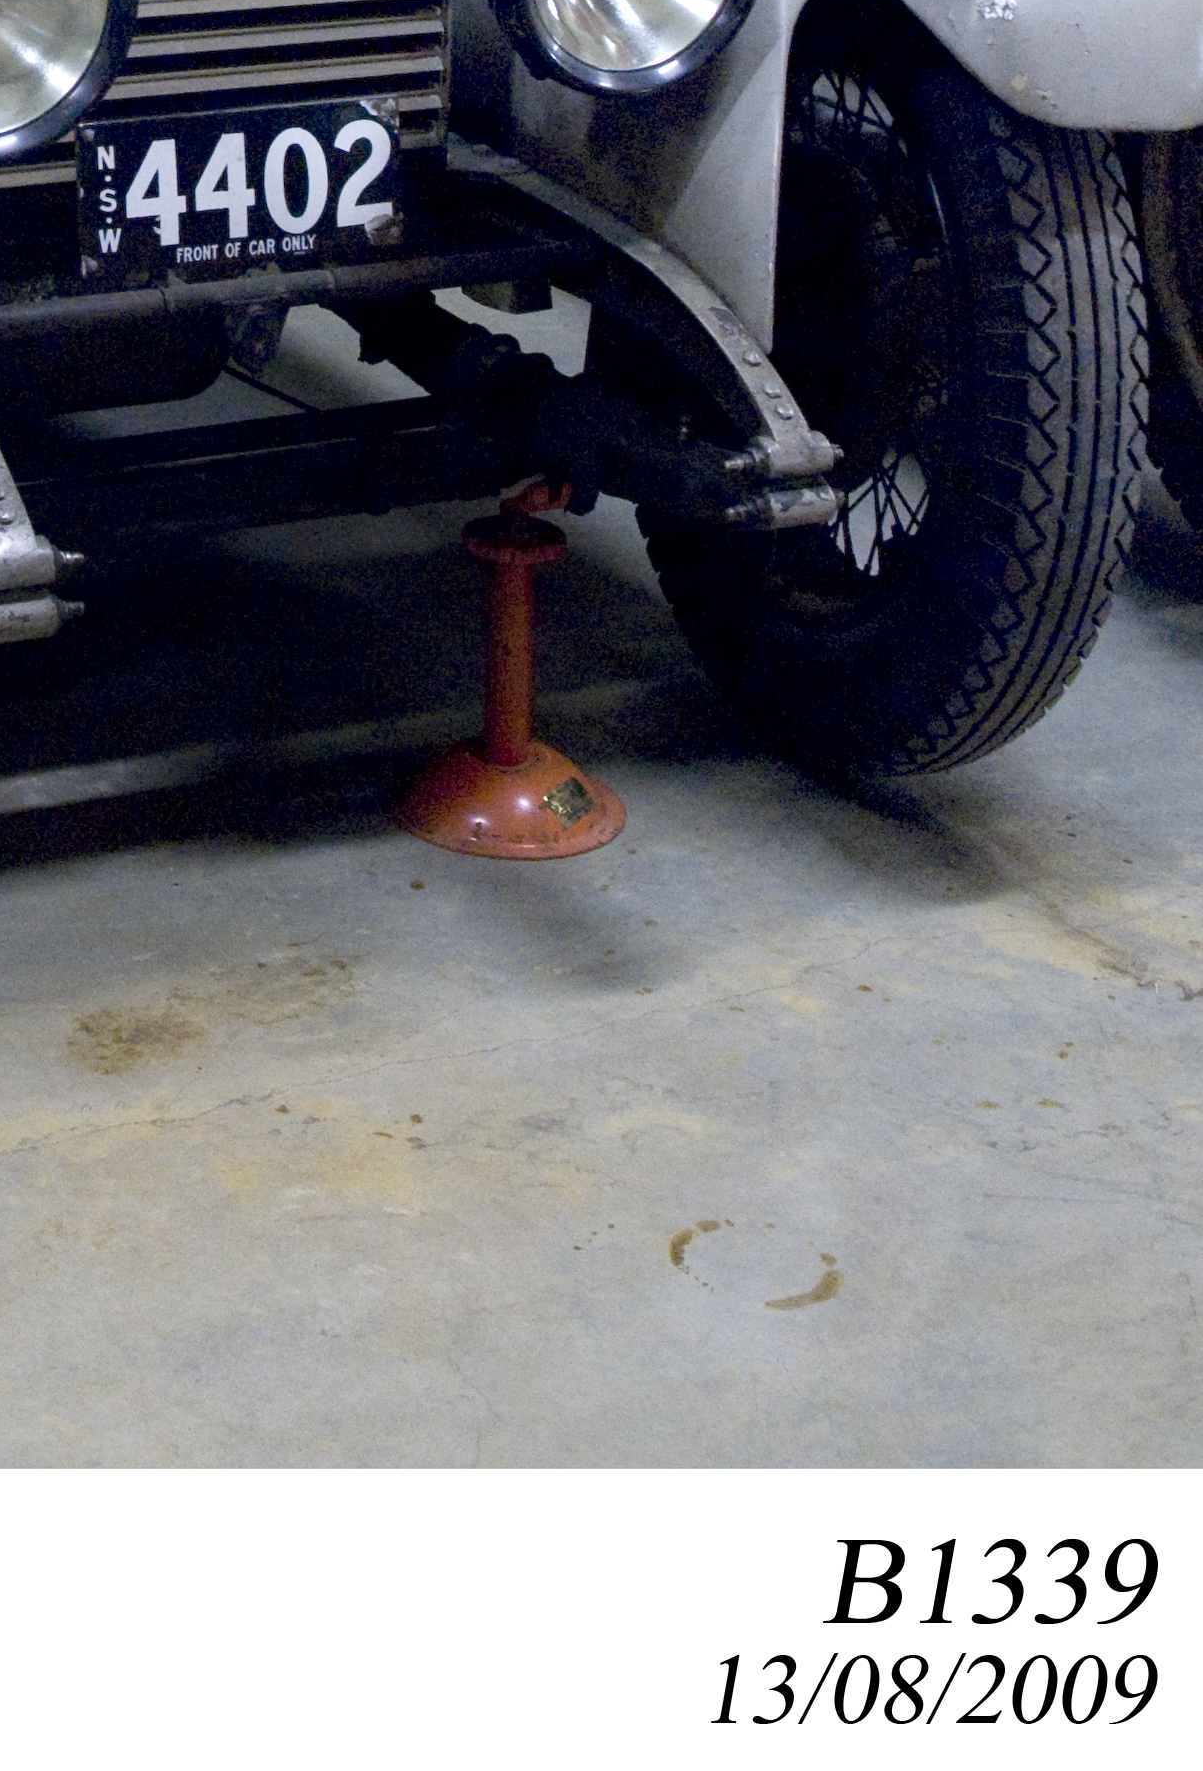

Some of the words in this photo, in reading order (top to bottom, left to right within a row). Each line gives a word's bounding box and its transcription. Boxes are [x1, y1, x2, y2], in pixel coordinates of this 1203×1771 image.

[125, 119, 394, 246] 4402
[176, 245, 219, 264] FRONT
[224, 242, 242, 259] OF
[248, 238, 276, 256] CAR
[282, 234, 317, 252] ONLY
